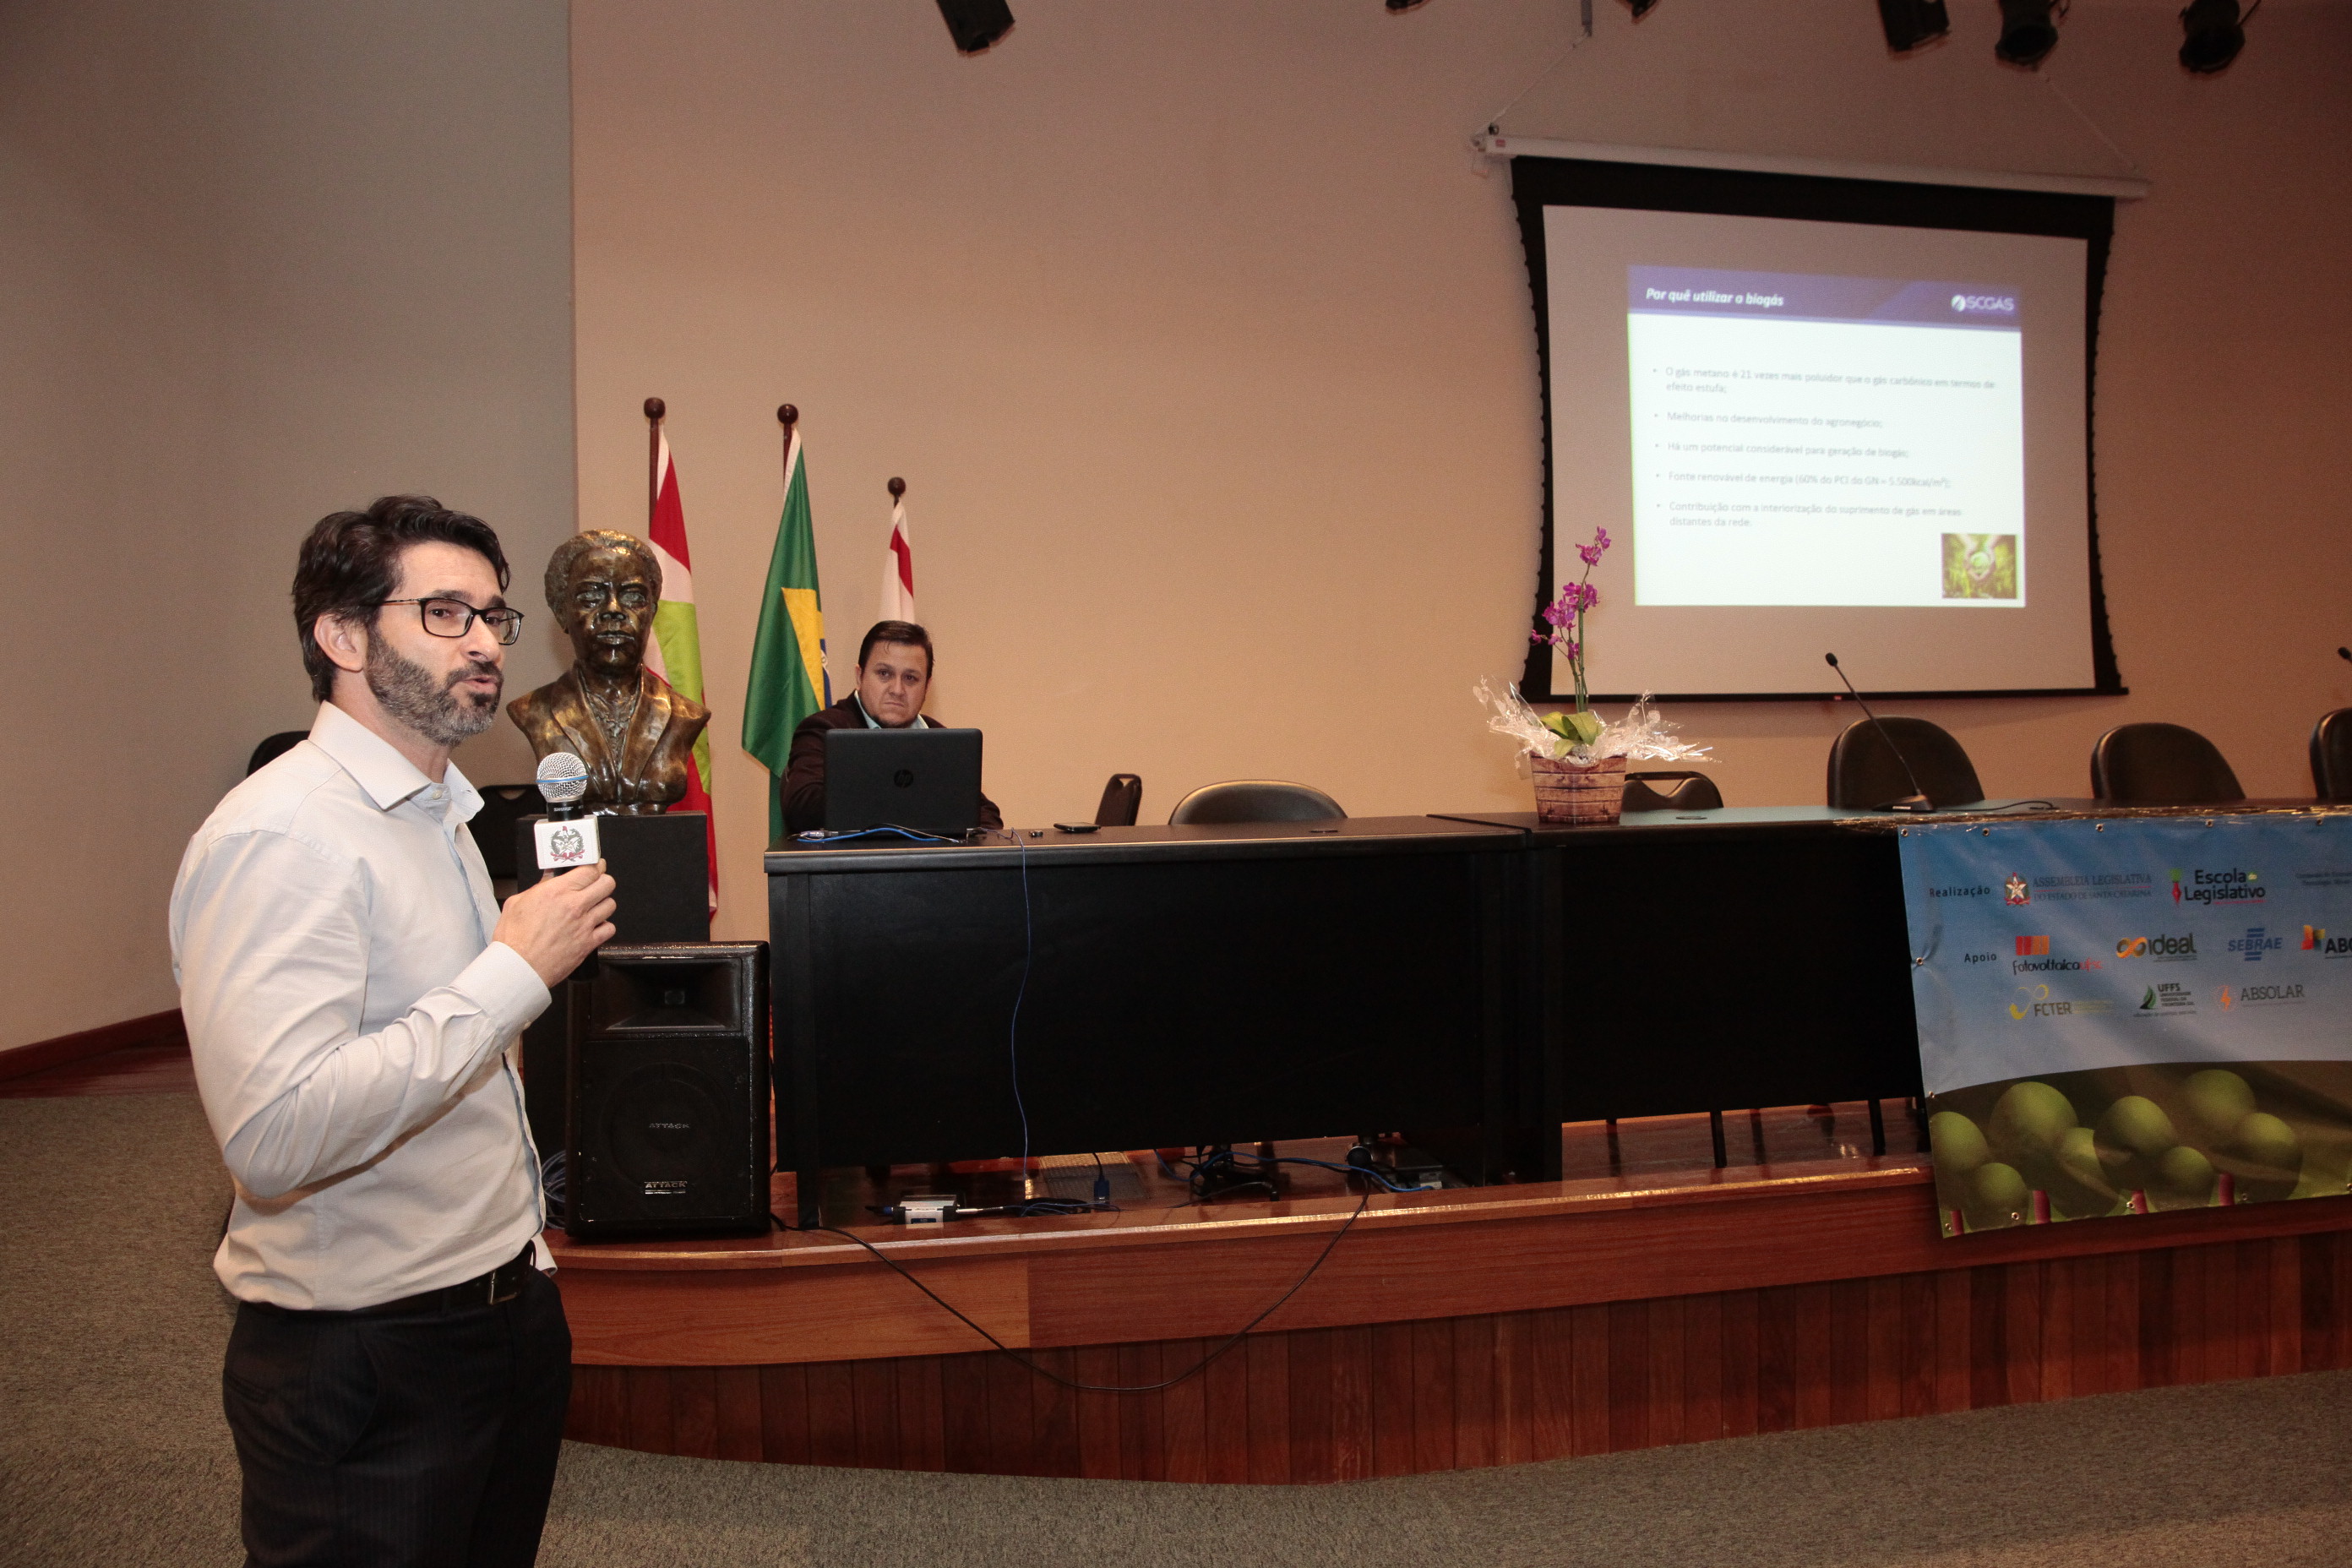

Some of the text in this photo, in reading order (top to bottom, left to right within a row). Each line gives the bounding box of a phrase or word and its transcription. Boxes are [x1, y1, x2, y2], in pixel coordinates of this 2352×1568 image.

[1646, 287, 1784, 308] Por quê utilizar o biogás
[1665, 367, 1674, 376] O
[1675, 368, 1690, 379] gás
[1693, 369, 1729, 378] metano
[1740, 370, 1751, 379] 21
[1754, 372, 1779, 380] vezes
[1781, 372, 1802, 381] mais
[1805, 373, 1843, 384] poluidor
[1845, 376, 1862, 385] que
[1872, 375, 1887, 386] gás
[1666, 382, 1727, 394] efeito estufa;
[1667, 411, 1713, 422] Melhorias
[1716, 414, 1729, 422] no
[1730, 413, 1809, 426] desenvolvimento
[1810, 416, 1823, 426] do
[1668, 442, 1680, 450] Há
[1701, 443, 1744, 454] potencial
[1745, 444, 1803, 455] considerável
[1805, 446, 1825, 456] para
[1827, 446, 1862, 458] geração
[1865, 447, 1876, 456] de
[1669, 471, 1696, 481] Fonte
[1697, 473, 1743, 482] renovável
[1745, 473, 1756, 482] de
[1759, 475, 1793, 486] energia
[1794, 474, 1818, 485] (60%
[1820, 475, 1832, 484] do
[1669, 501, 1729, 514] Contribuição
[1731, 504, 1751, 512] com
[1761, 503, 1821, 514] interiorização
[1839, 505, 1890, 516] suprimento
[1892, 506, 1903, 514] de
[1905, 507, 1919, 517] gás
[1669, 517, 1752, 527] distantes da rede.
[896, 769, 912, 788] hp
[2092, 874, 2153, 886] LEGISLATIVA
[2194, 868, 2246, 885] Escola
[1929, 885, 1991, 898] Realização
[2184, 884, 2267, 905] Legislativo
[2148, 932, 2197, 956] ideal
[2228, 937, 2284, 952] SEBRAE
[1964, 952, 1997, 964] Apoio
[2157, 983, 2180, 993] UFFS
[2240, 984, 2306, 1001] ABSOLAR
[2034, 1002, 2072, 1016] FCTER
